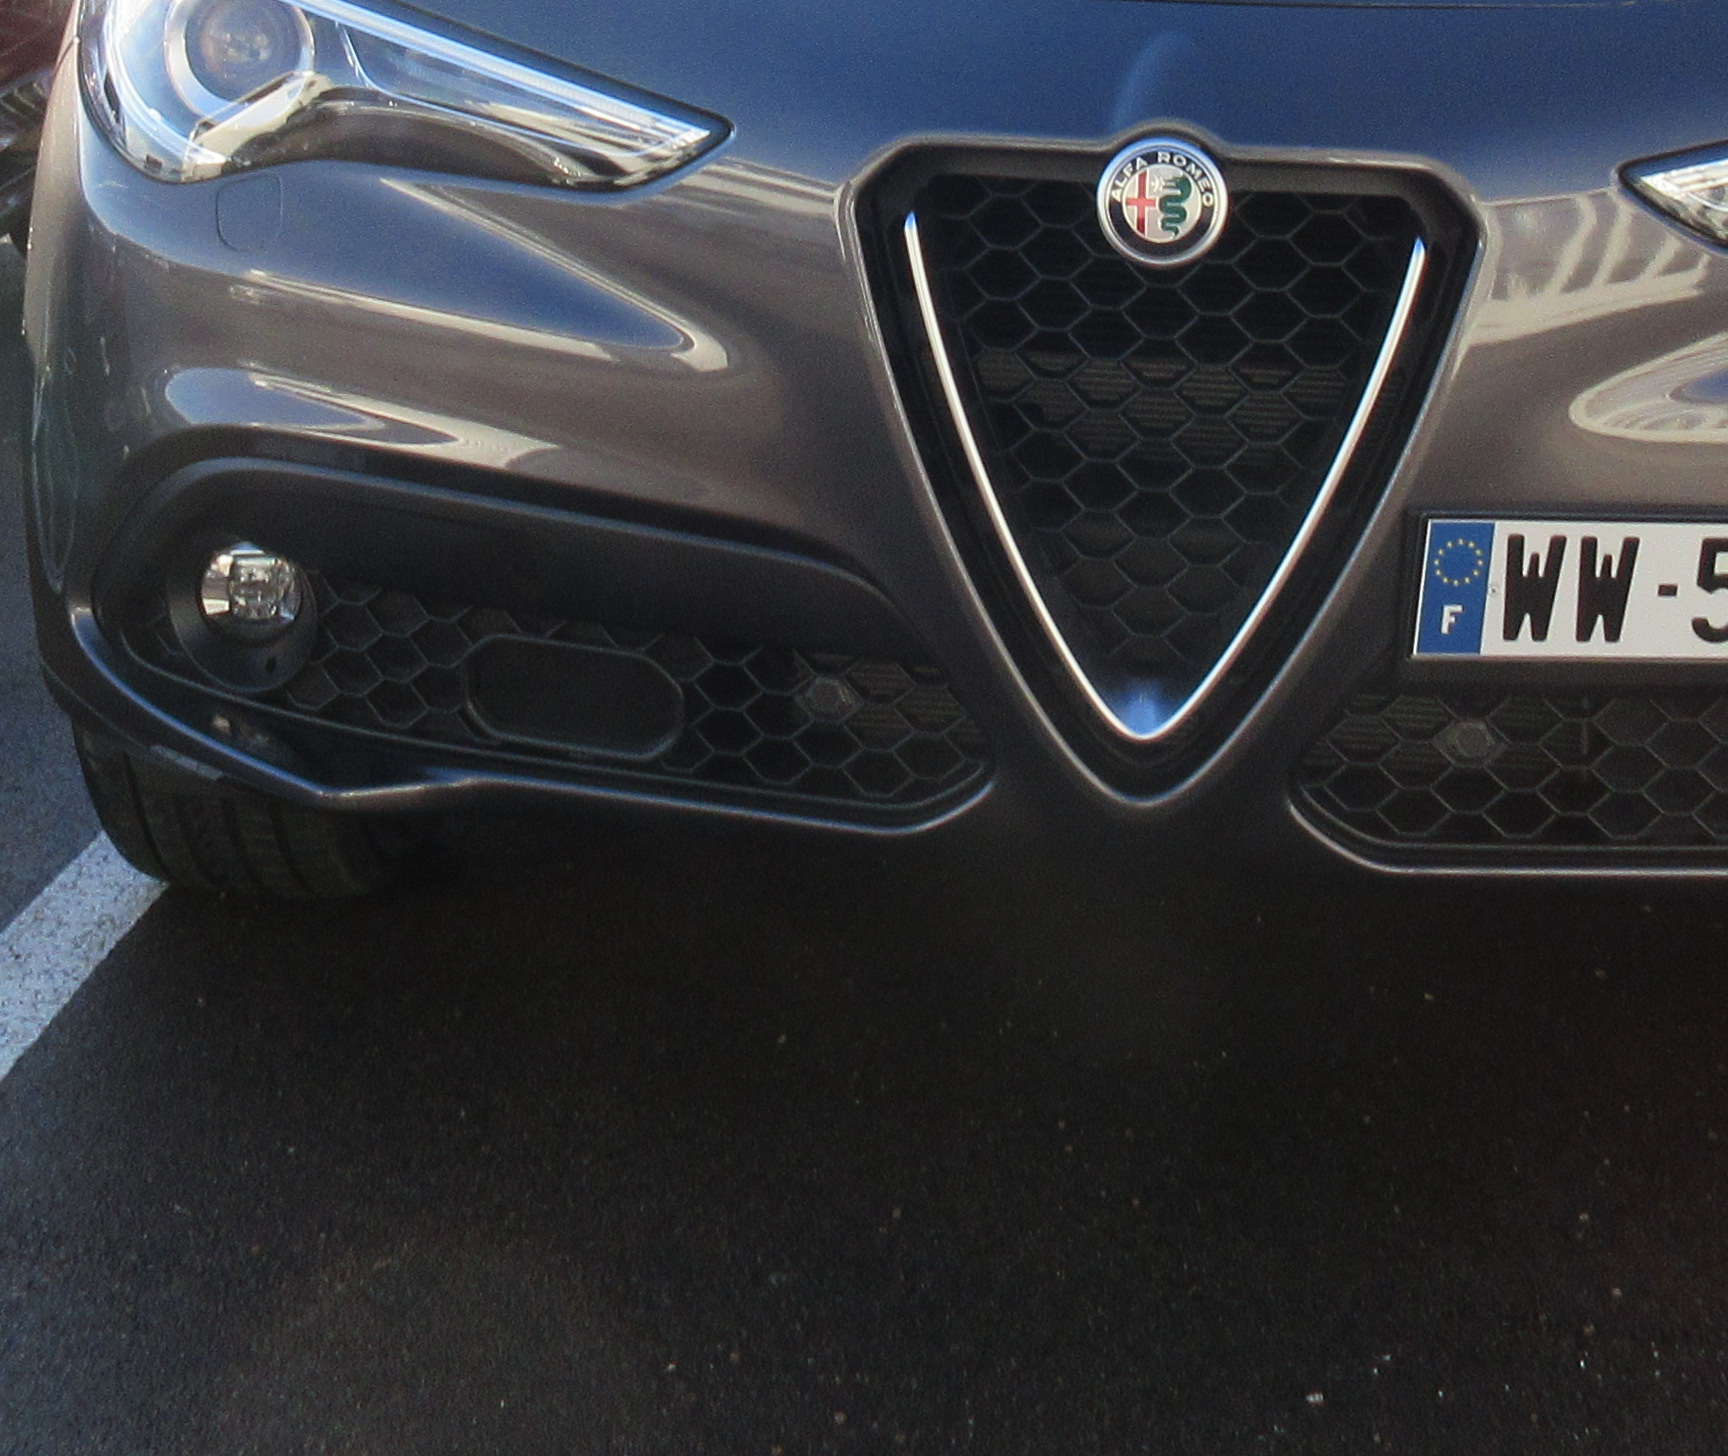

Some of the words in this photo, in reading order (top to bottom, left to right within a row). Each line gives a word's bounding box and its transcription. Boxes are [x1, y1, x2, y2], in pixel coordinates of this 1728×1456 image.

[1110, 156, 1148, 203] ALFA
[1158, 151, 1214, 207] ROMEO
[1440, 604, 1464, 635] F
